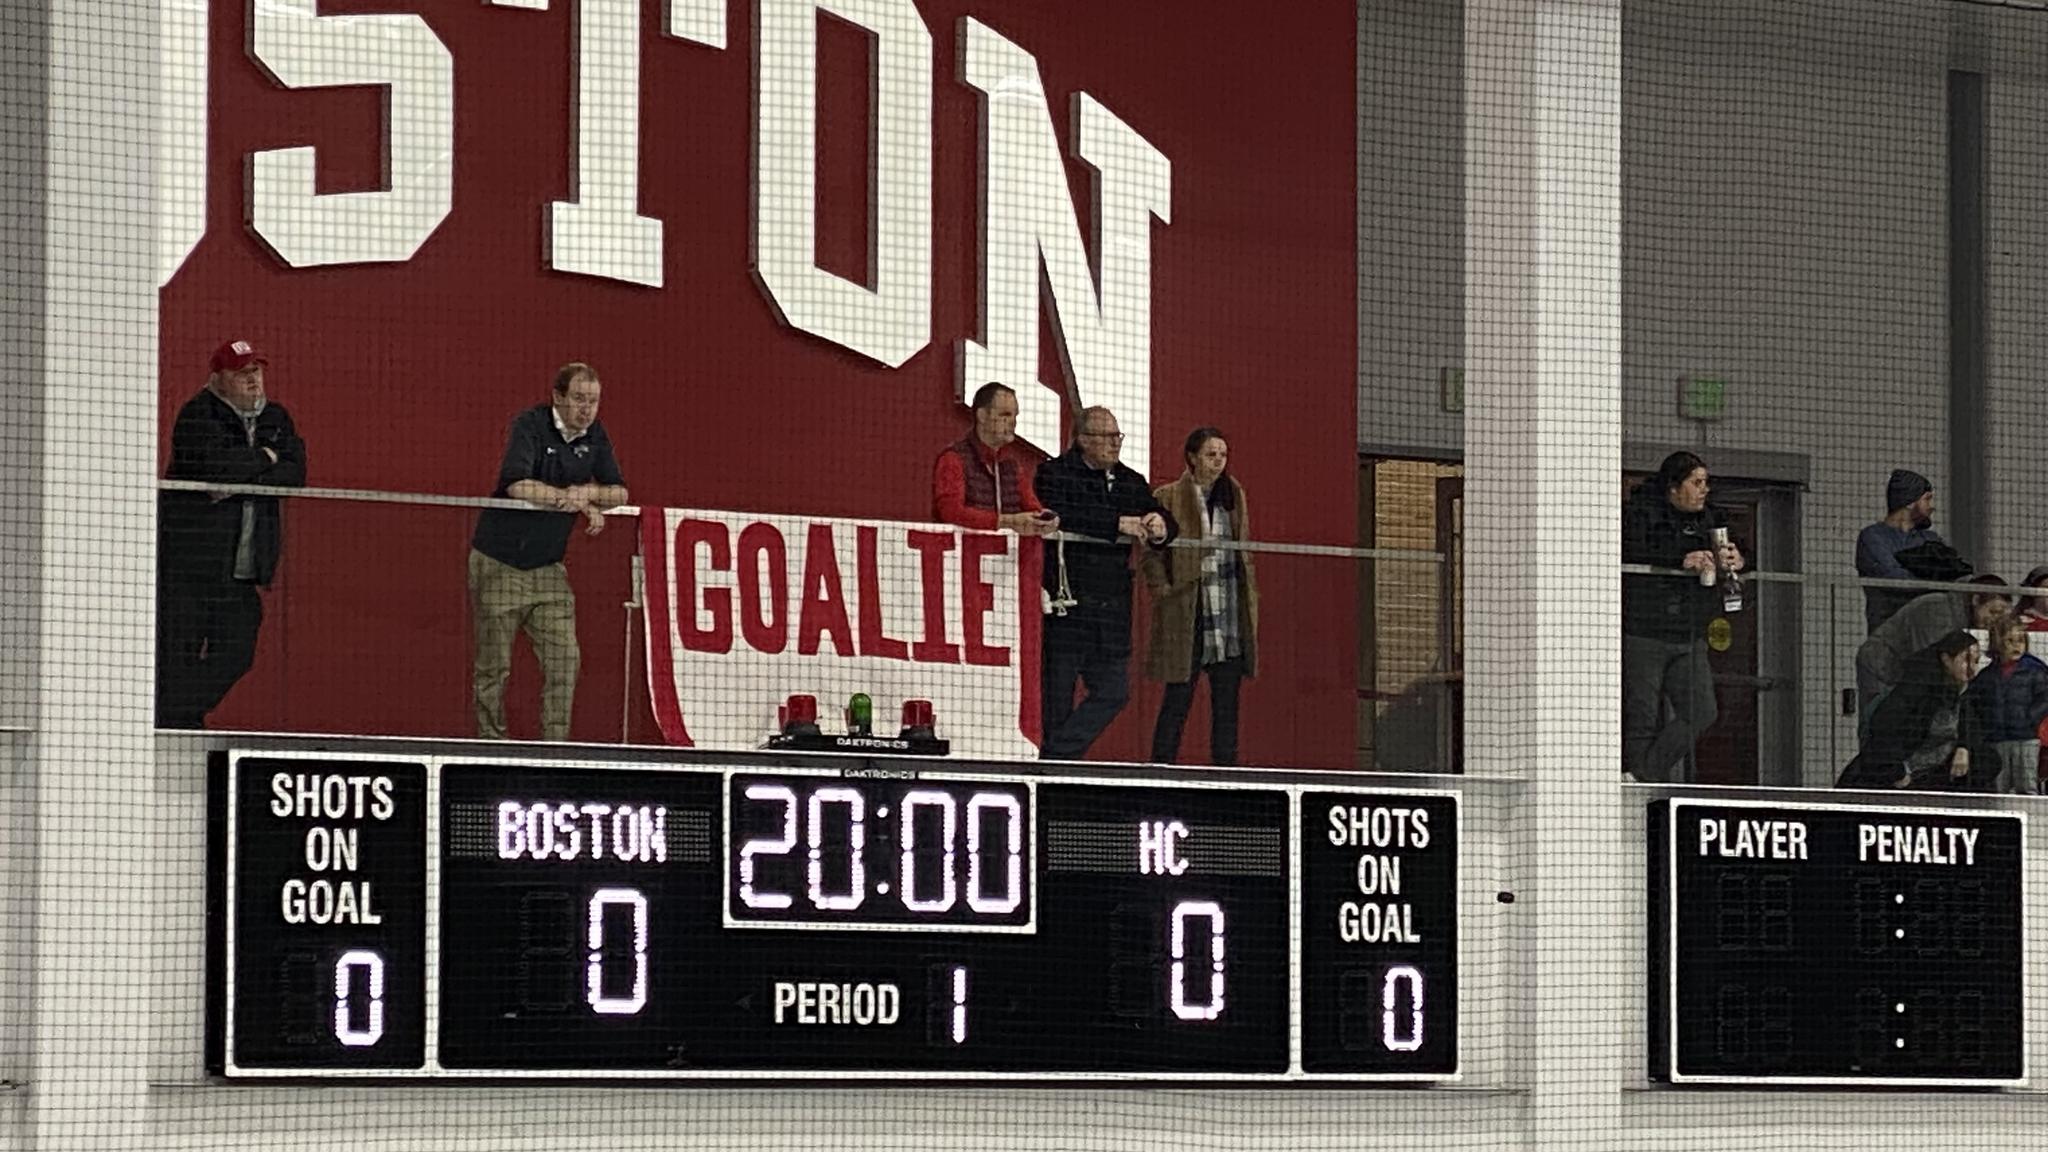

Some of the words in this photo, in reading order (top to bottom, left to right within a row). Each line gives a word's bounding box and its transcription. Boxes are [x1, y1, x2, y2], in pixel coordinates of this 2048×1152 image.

[159, 0, 1172, 484] STON
[675, 518, 1011, 667] GOALIE
[270, 772, 394, 821] SHOTS
[306, 826, 358, 872] ON
[497, 801, 667, 863] BOSTON
[739, 785, 1021, 914] 20:00
[1138, 820, 1190, 876] HC
[1328, 805, 1431, 849] SHOTS
[1699, 818, 1808, 860] PLAYER
[1858, 824, 1980, 865] PENALTY
[282, 879, 382, 925] GOAL
[1357, 854, 1400, 895] ON
[1339, 901, 1421, 943] GOAL
[587, 888, 648, 1014] 0
[1170, 900, 1225, 1020] 0
[334, 950, 384, 1046] 0
[774, 982, 900, 1025] PERIOD
[952, 968, 967, 1044] 1
[1382, 965, 1424, 1052] 0
